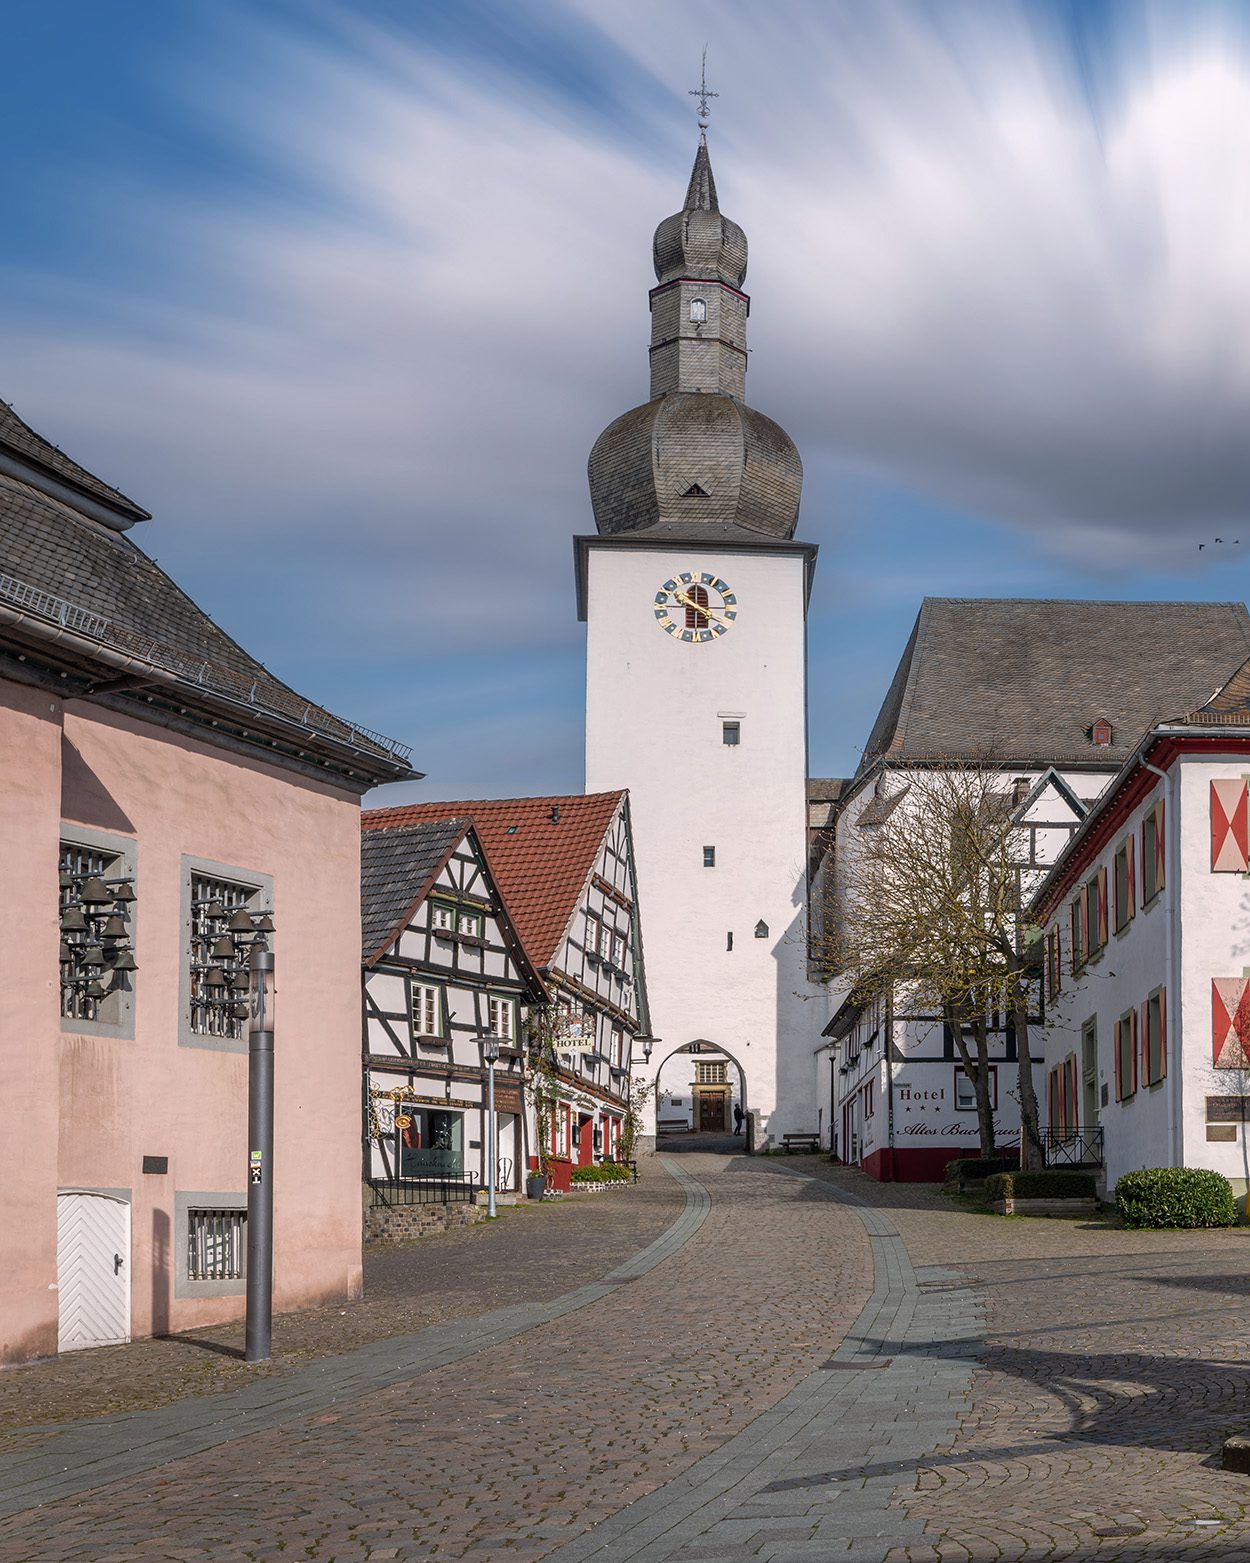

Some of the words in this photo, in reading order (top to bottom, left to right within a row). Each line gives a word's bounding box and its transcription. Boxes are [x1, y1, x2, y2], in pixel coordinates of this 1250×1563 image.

[556, 1039, 591, 1048] HOTEL
[900, 1089, 944, 1100] Hotel
[896, 1123, 937, 1136] Altes
[941, 1120, 1021, 1136] Bachaus
